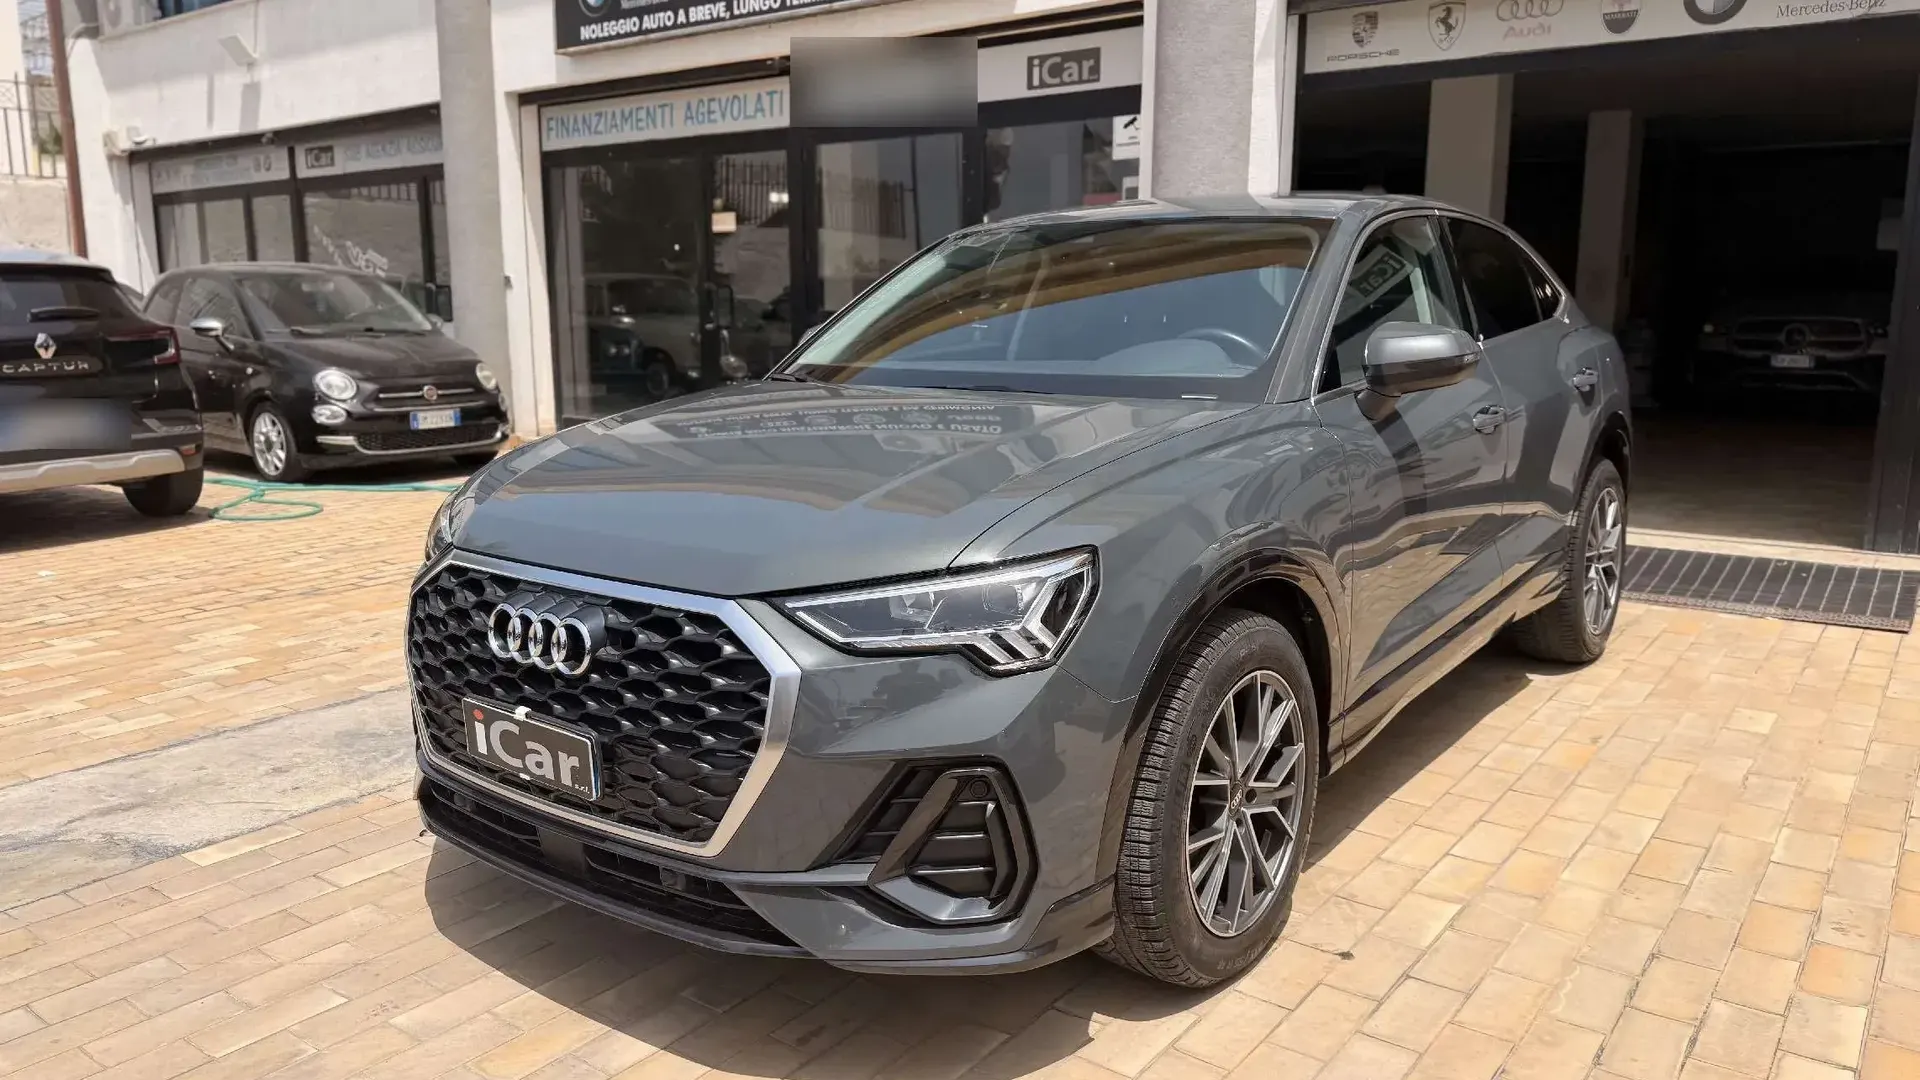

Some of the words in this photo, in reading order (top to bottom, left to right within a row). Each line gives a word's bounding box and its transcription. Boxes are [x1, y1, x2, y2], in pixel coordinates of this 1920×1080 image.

[580, 16, 640, 40] NOLEGGIO
[642, 10, 675, 30] AUTO
[677, 8, 687, 24] A
[688, 1, 730, 23] BREVE,
[733, 0, 781, 15] LUNGO
[1502, 22, 1552, 41] Audi
[1327, 49, 1400, 62] PORSCHE
[1032, 56, 1095, 86] iCar
[546, 102, 675, 141] FINANZIAMENTI
[683, 89, 784, 126] AGEVOLATI
[2, 360, 90, 373] CAPTUR
[473, 708, 580, 788] iCar
